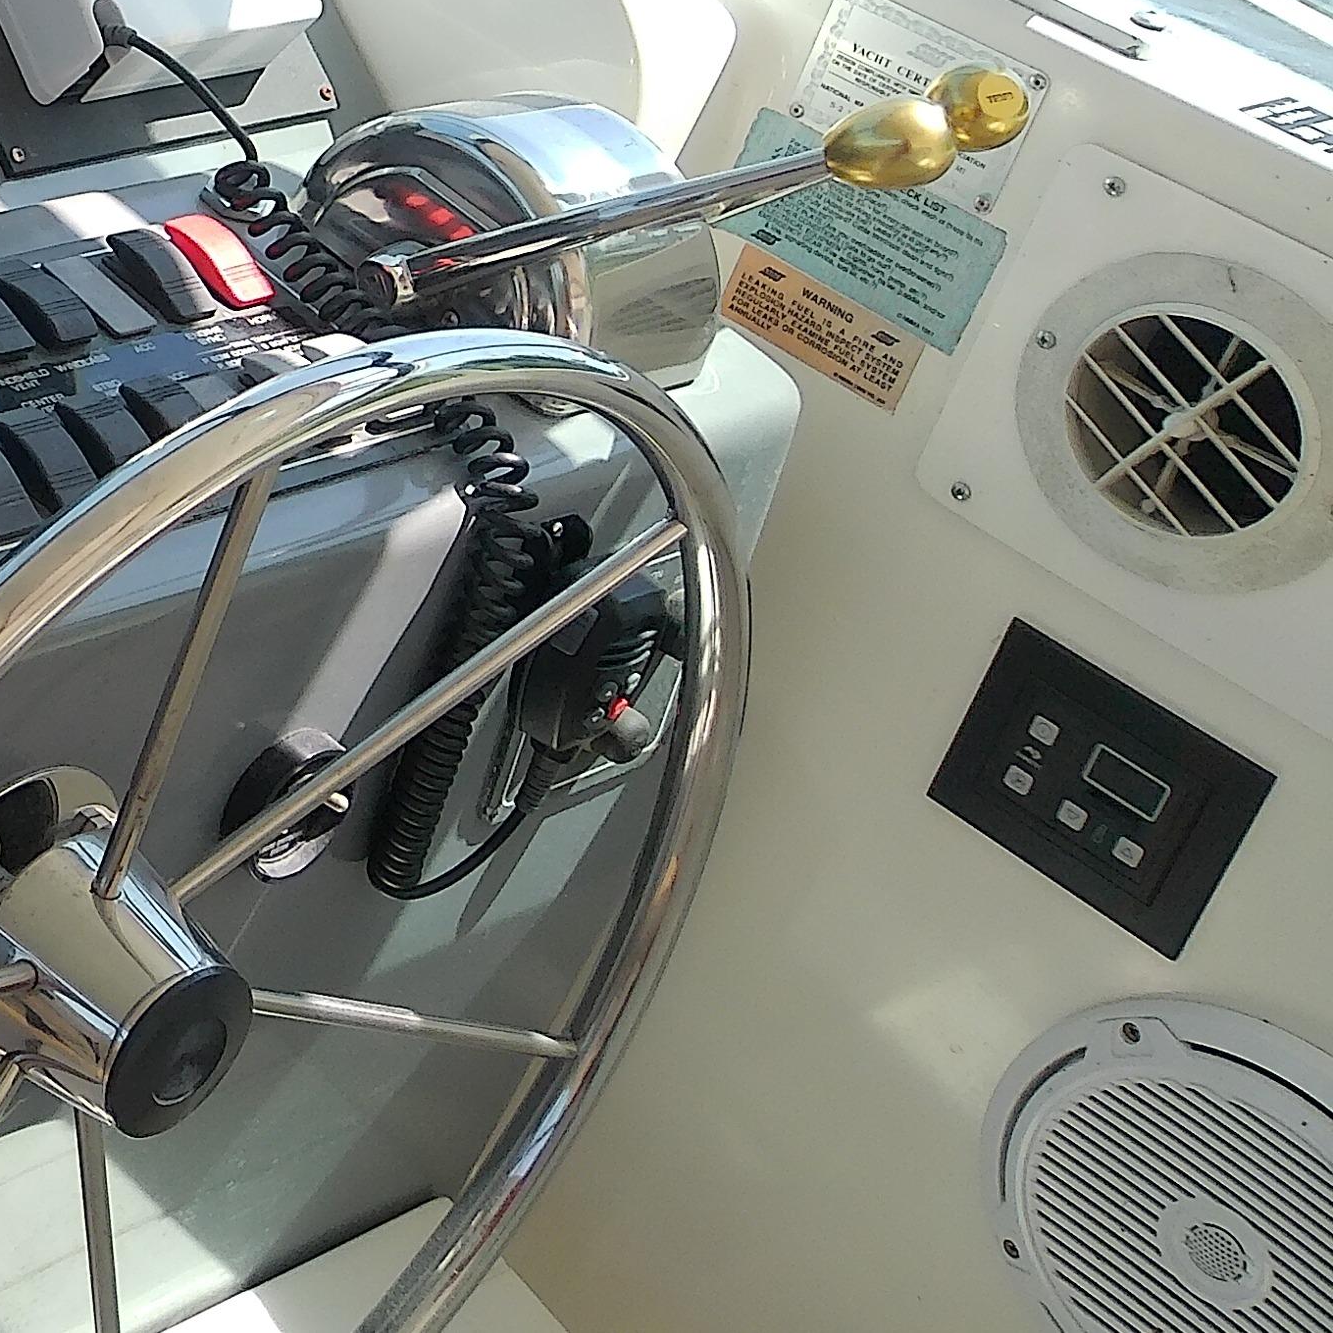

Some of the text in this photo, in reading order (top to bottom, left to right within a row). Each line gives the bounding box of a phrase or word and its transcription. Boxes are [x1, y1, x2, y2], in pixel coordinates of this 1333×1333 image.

[820, 81, 852, 102] NATIONAL
[850, 42, 891, 68] YACHT
[895, 64, 932, 88] CERT
[922, 197, 947, 215] LIST
[737, 279, 786, 311] EXPLOSION
[824, 329, 863, 355] INSPECT
[863, 351, 900, 377] SYSTEM
[740, 271, 785, 301] LEAKING
[789, 299, 817, 319] FUEL
[821, 317, 833, 328] IS
[851, 334, 876, 353] FIRE
[881, 351, 904, 369] AND
[799, 287, 855, 324] WARNING
[731, 294, 750, 309] FOR
[750, 305, 780, 327] LEAKS
[780, 322, 795, 336] OR
[795, 331, 849, 367] CORROSION
[848, 362, 862, 375] AT
[862, 371, 893, 393] LEAST
[789, 319, 830, 346] EXAMINE
[832, 343, 857, 363] FUEL
[858, 358, 896, 385] SYSTEM
